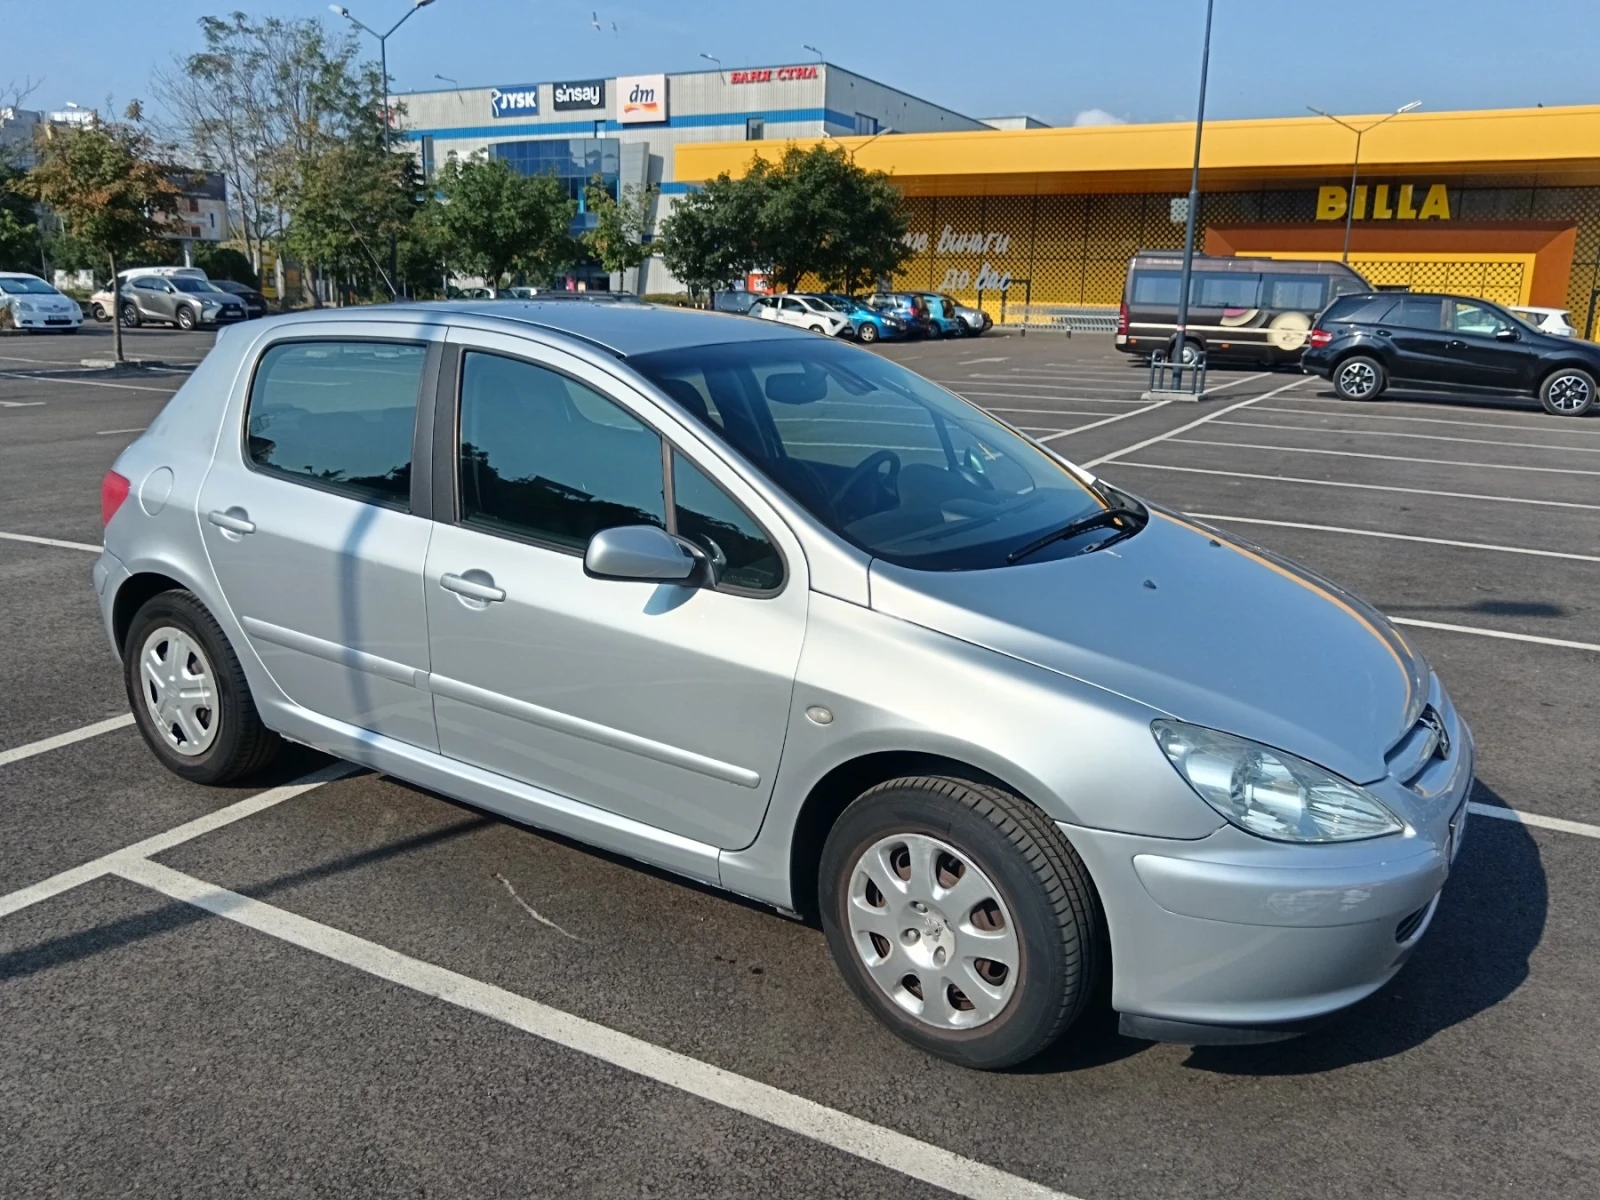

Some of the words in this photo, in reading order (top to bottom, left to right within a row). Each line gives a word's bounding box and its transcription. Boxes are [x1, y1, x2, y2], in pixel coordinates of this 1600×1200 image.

[731, 70, 772, 84] БАНЯ
[777, 66, 818, 81] СТИЛ
[500, 91, 537, 110] JYSK
[555, 84, 600, 105] sinsay
[629, 84, 655, 103] dm
[1316, 184, 1450, 220] BILLA
